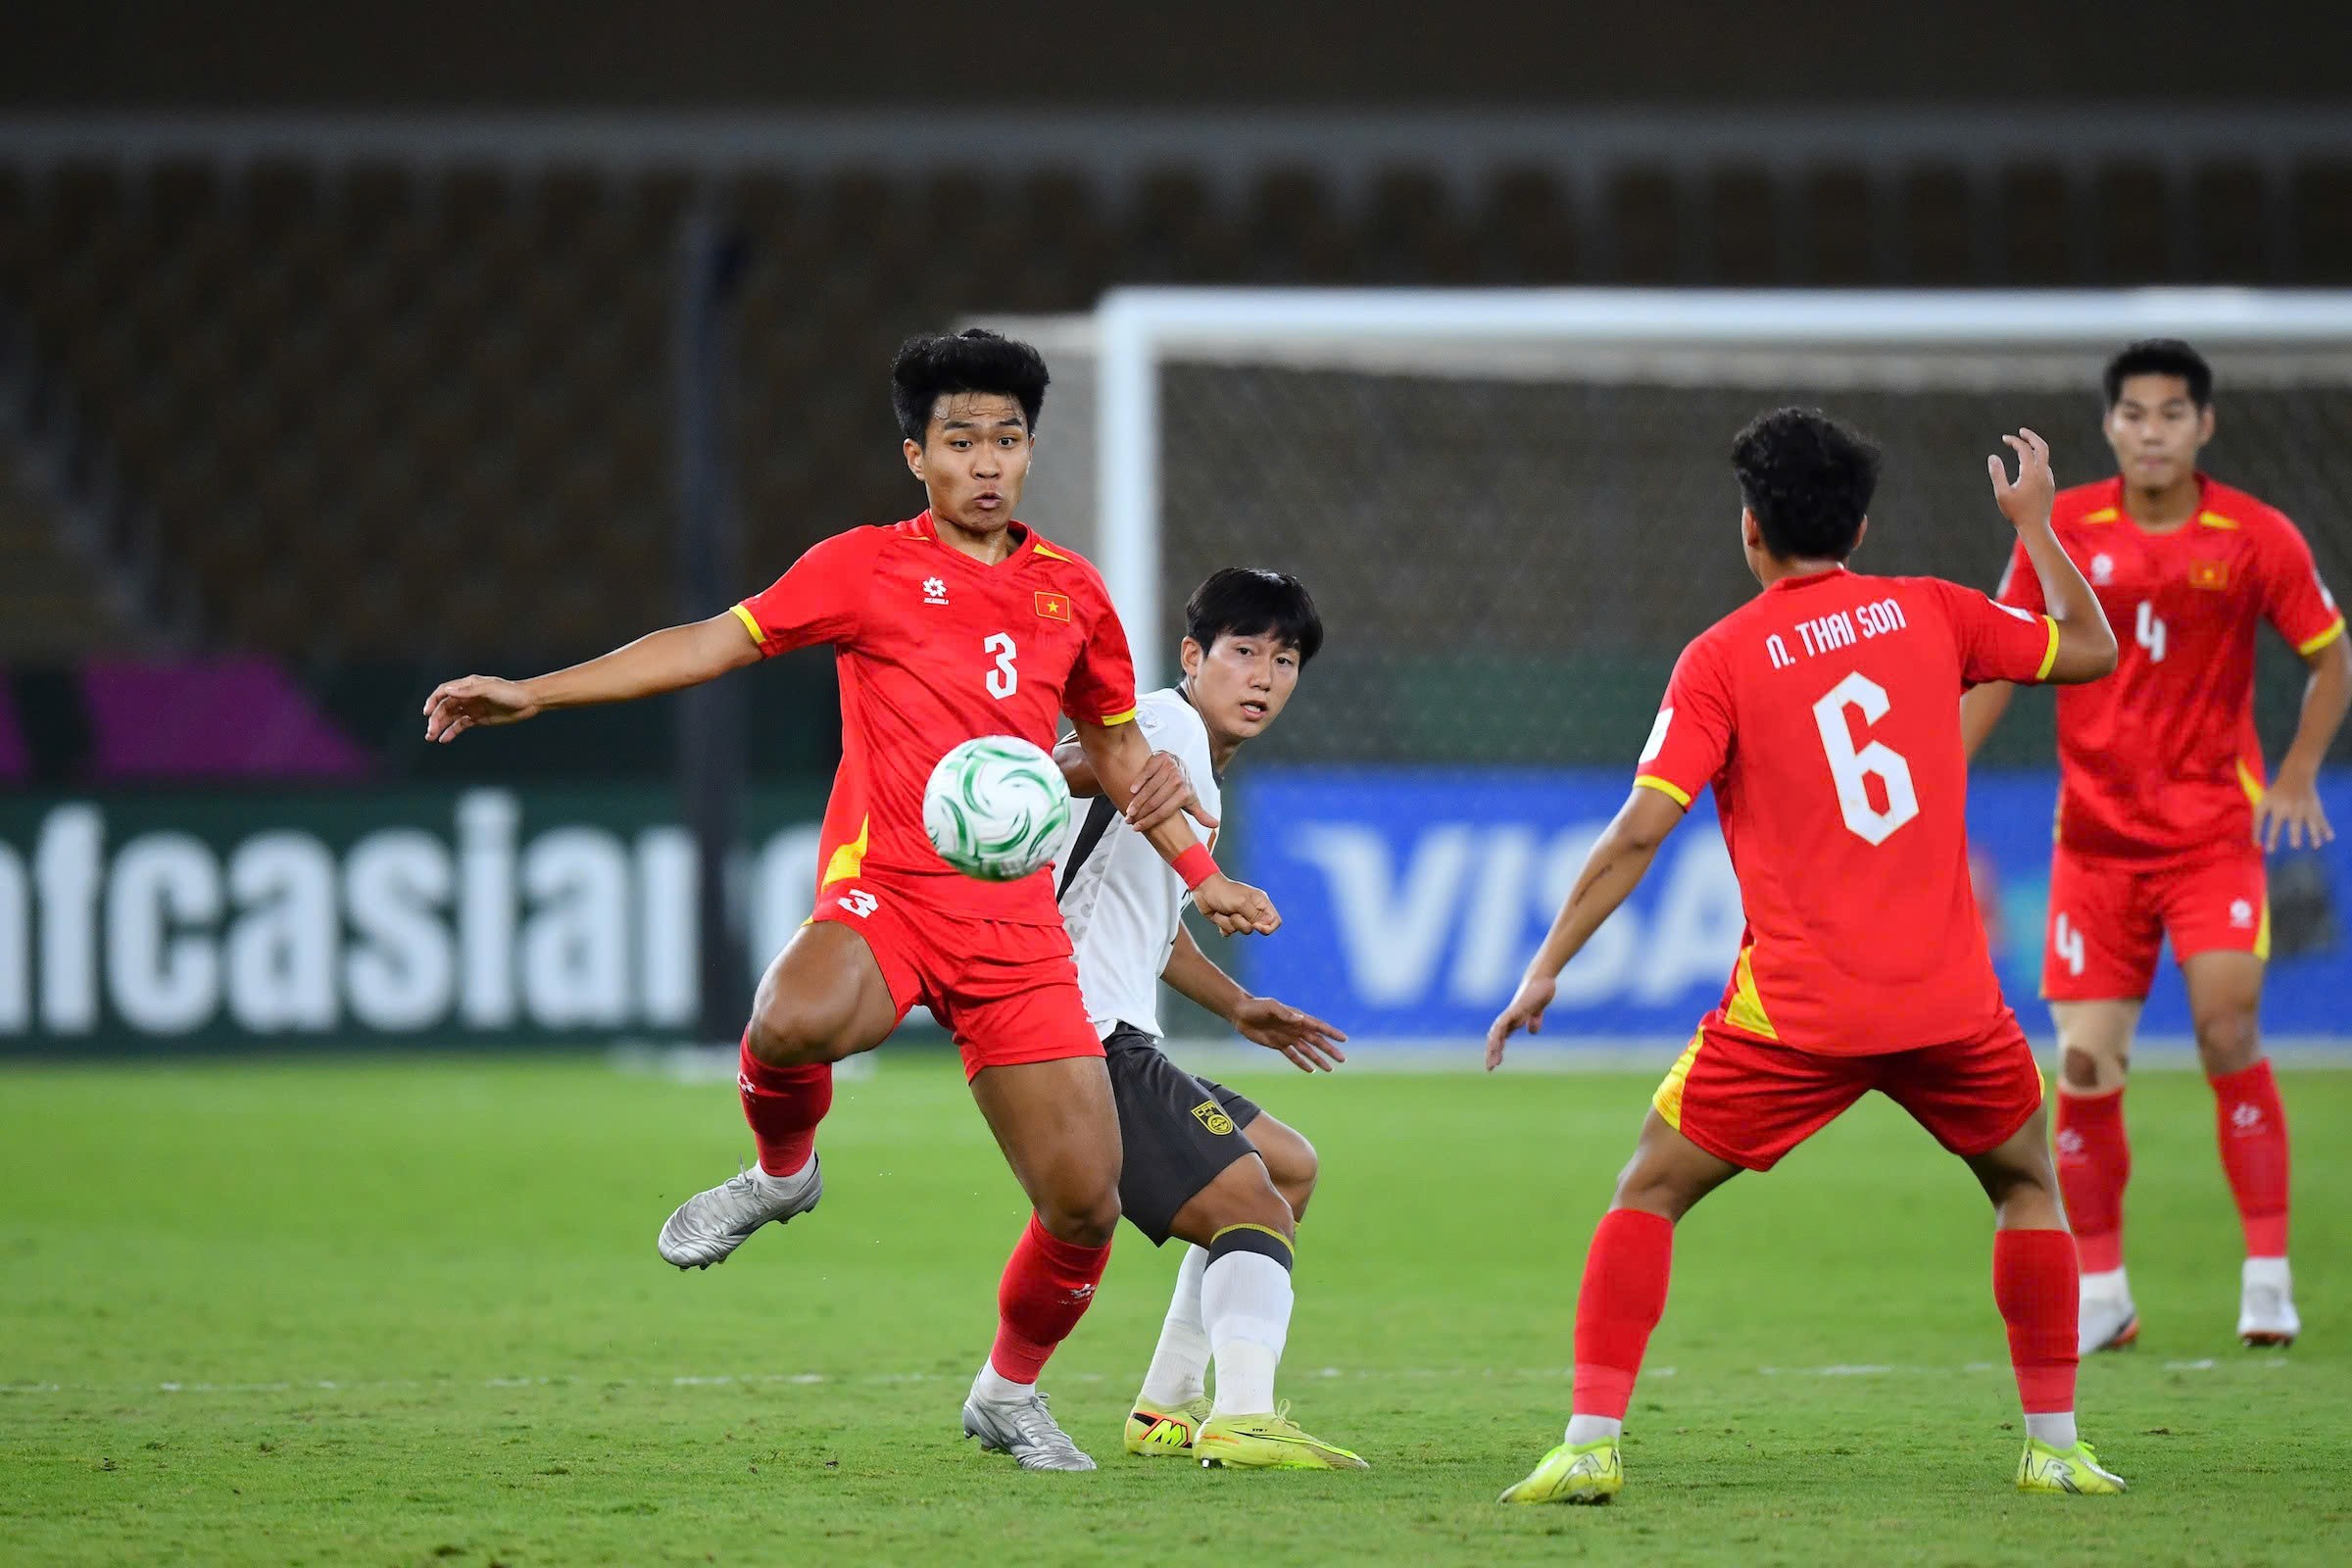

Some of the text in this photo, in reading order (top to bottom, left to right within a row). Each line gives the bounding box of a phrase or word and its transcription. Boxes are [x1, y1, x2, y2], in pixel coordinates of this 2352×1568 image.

[1795, 611, 1856, 658] THAI
[1857, 598, 1907, 638] SON
[2135, 599, 2167, 662] 4
[983, 632, 1018, 700] 3
[1812, 670, 1920, 847] 6
[837, 889, 879, 919] 3
[2054, 911, 2084, 976] 4
